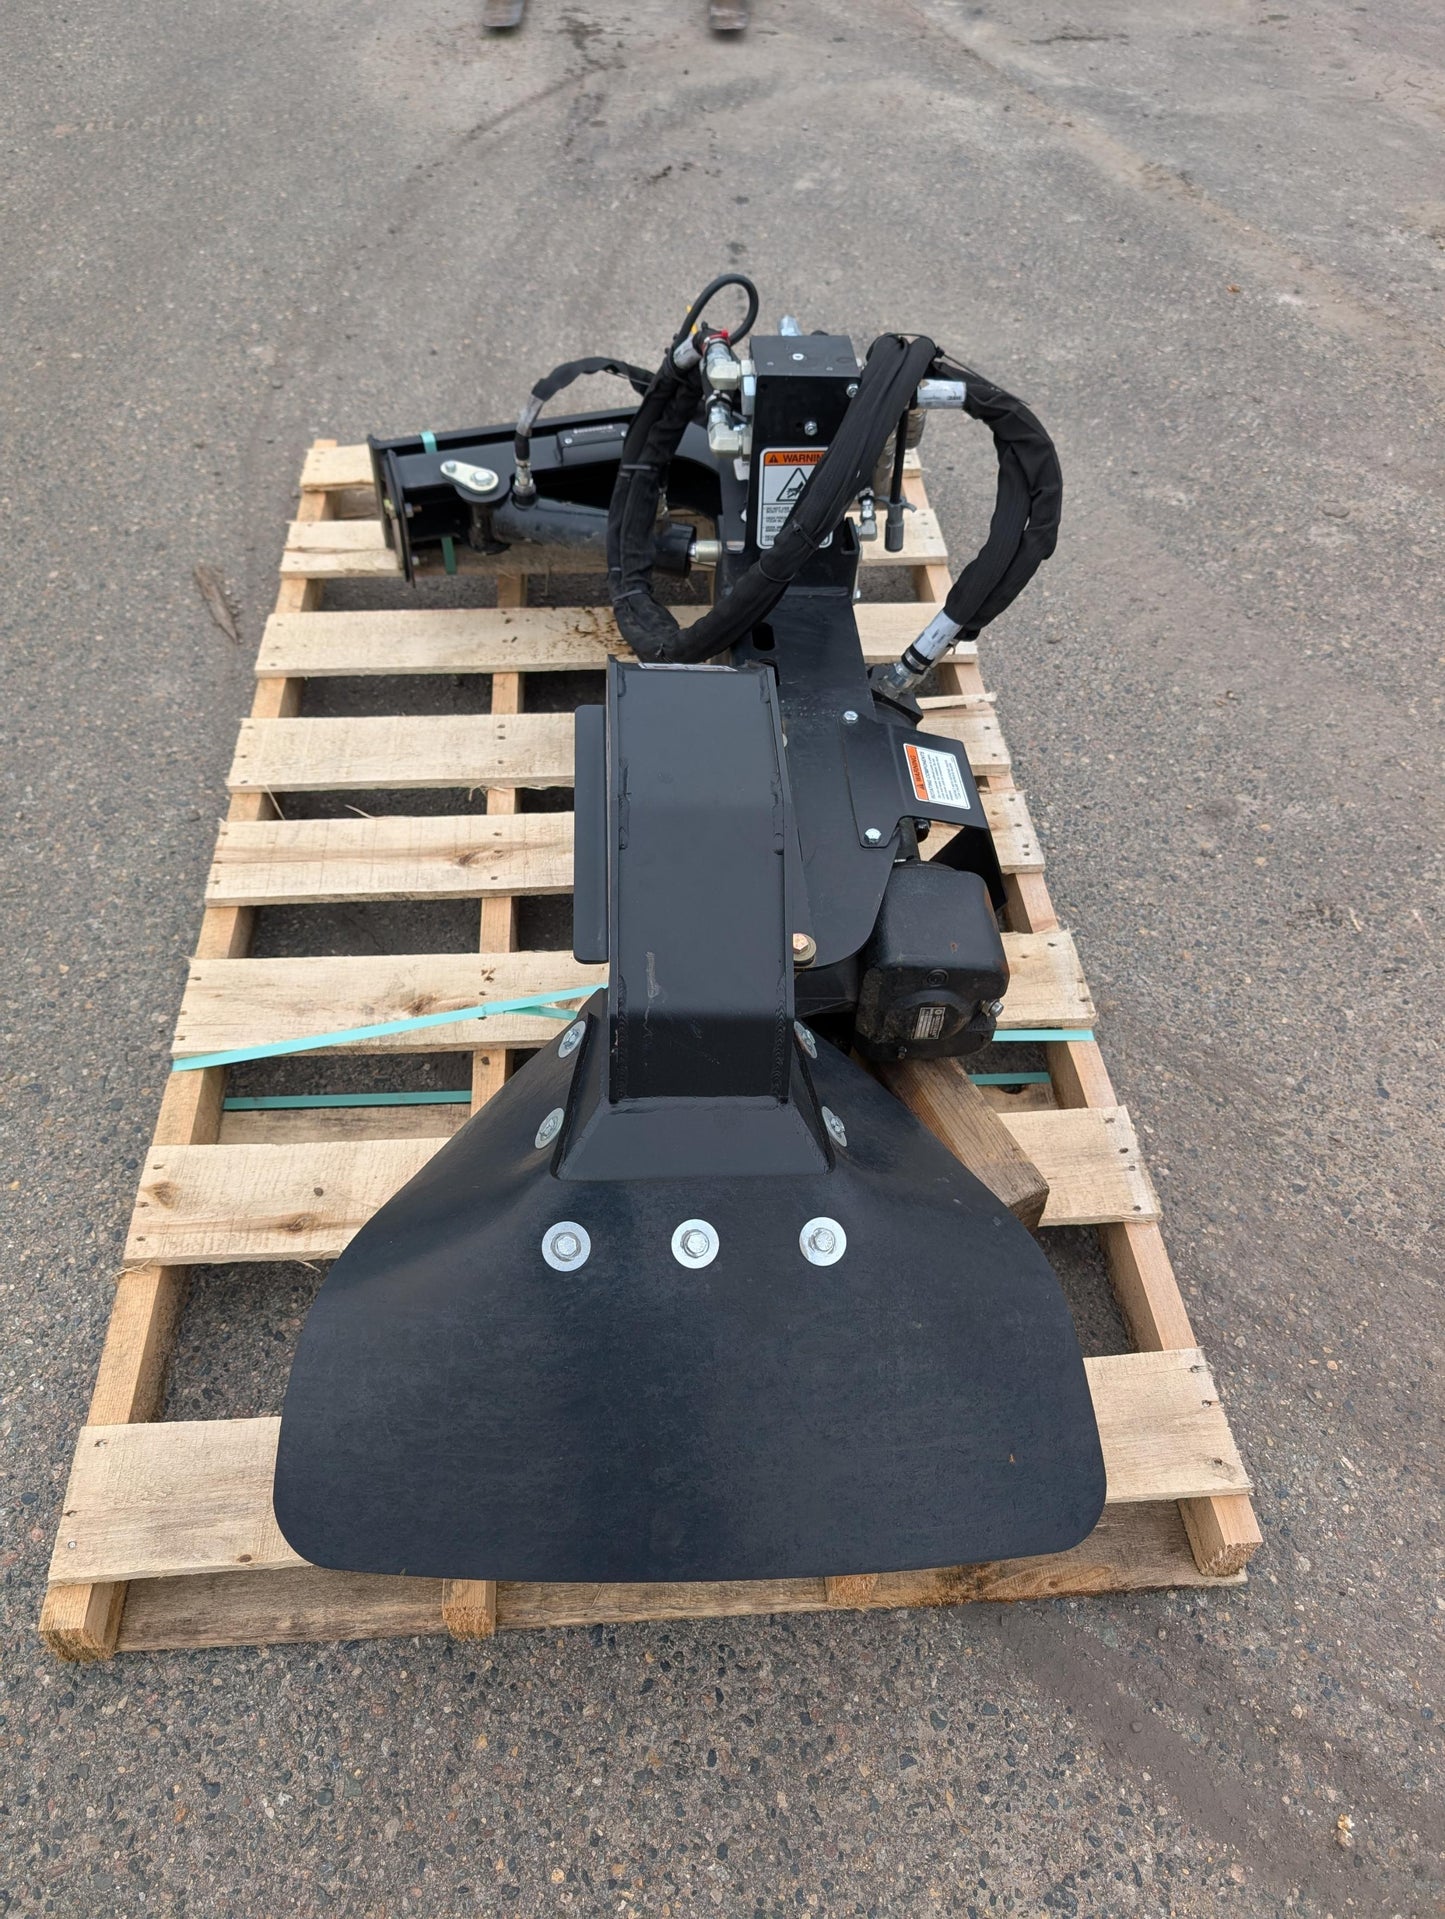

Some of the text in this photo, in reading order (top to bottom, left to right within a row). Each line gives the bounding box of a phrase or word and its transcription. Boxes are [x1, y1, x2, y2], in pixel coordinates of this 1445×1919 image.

[783, 454, 824, 463] WARNIN
[910, 755, 921, 781] WARNING
[919, 751, 931, 778] COMPONENTS
